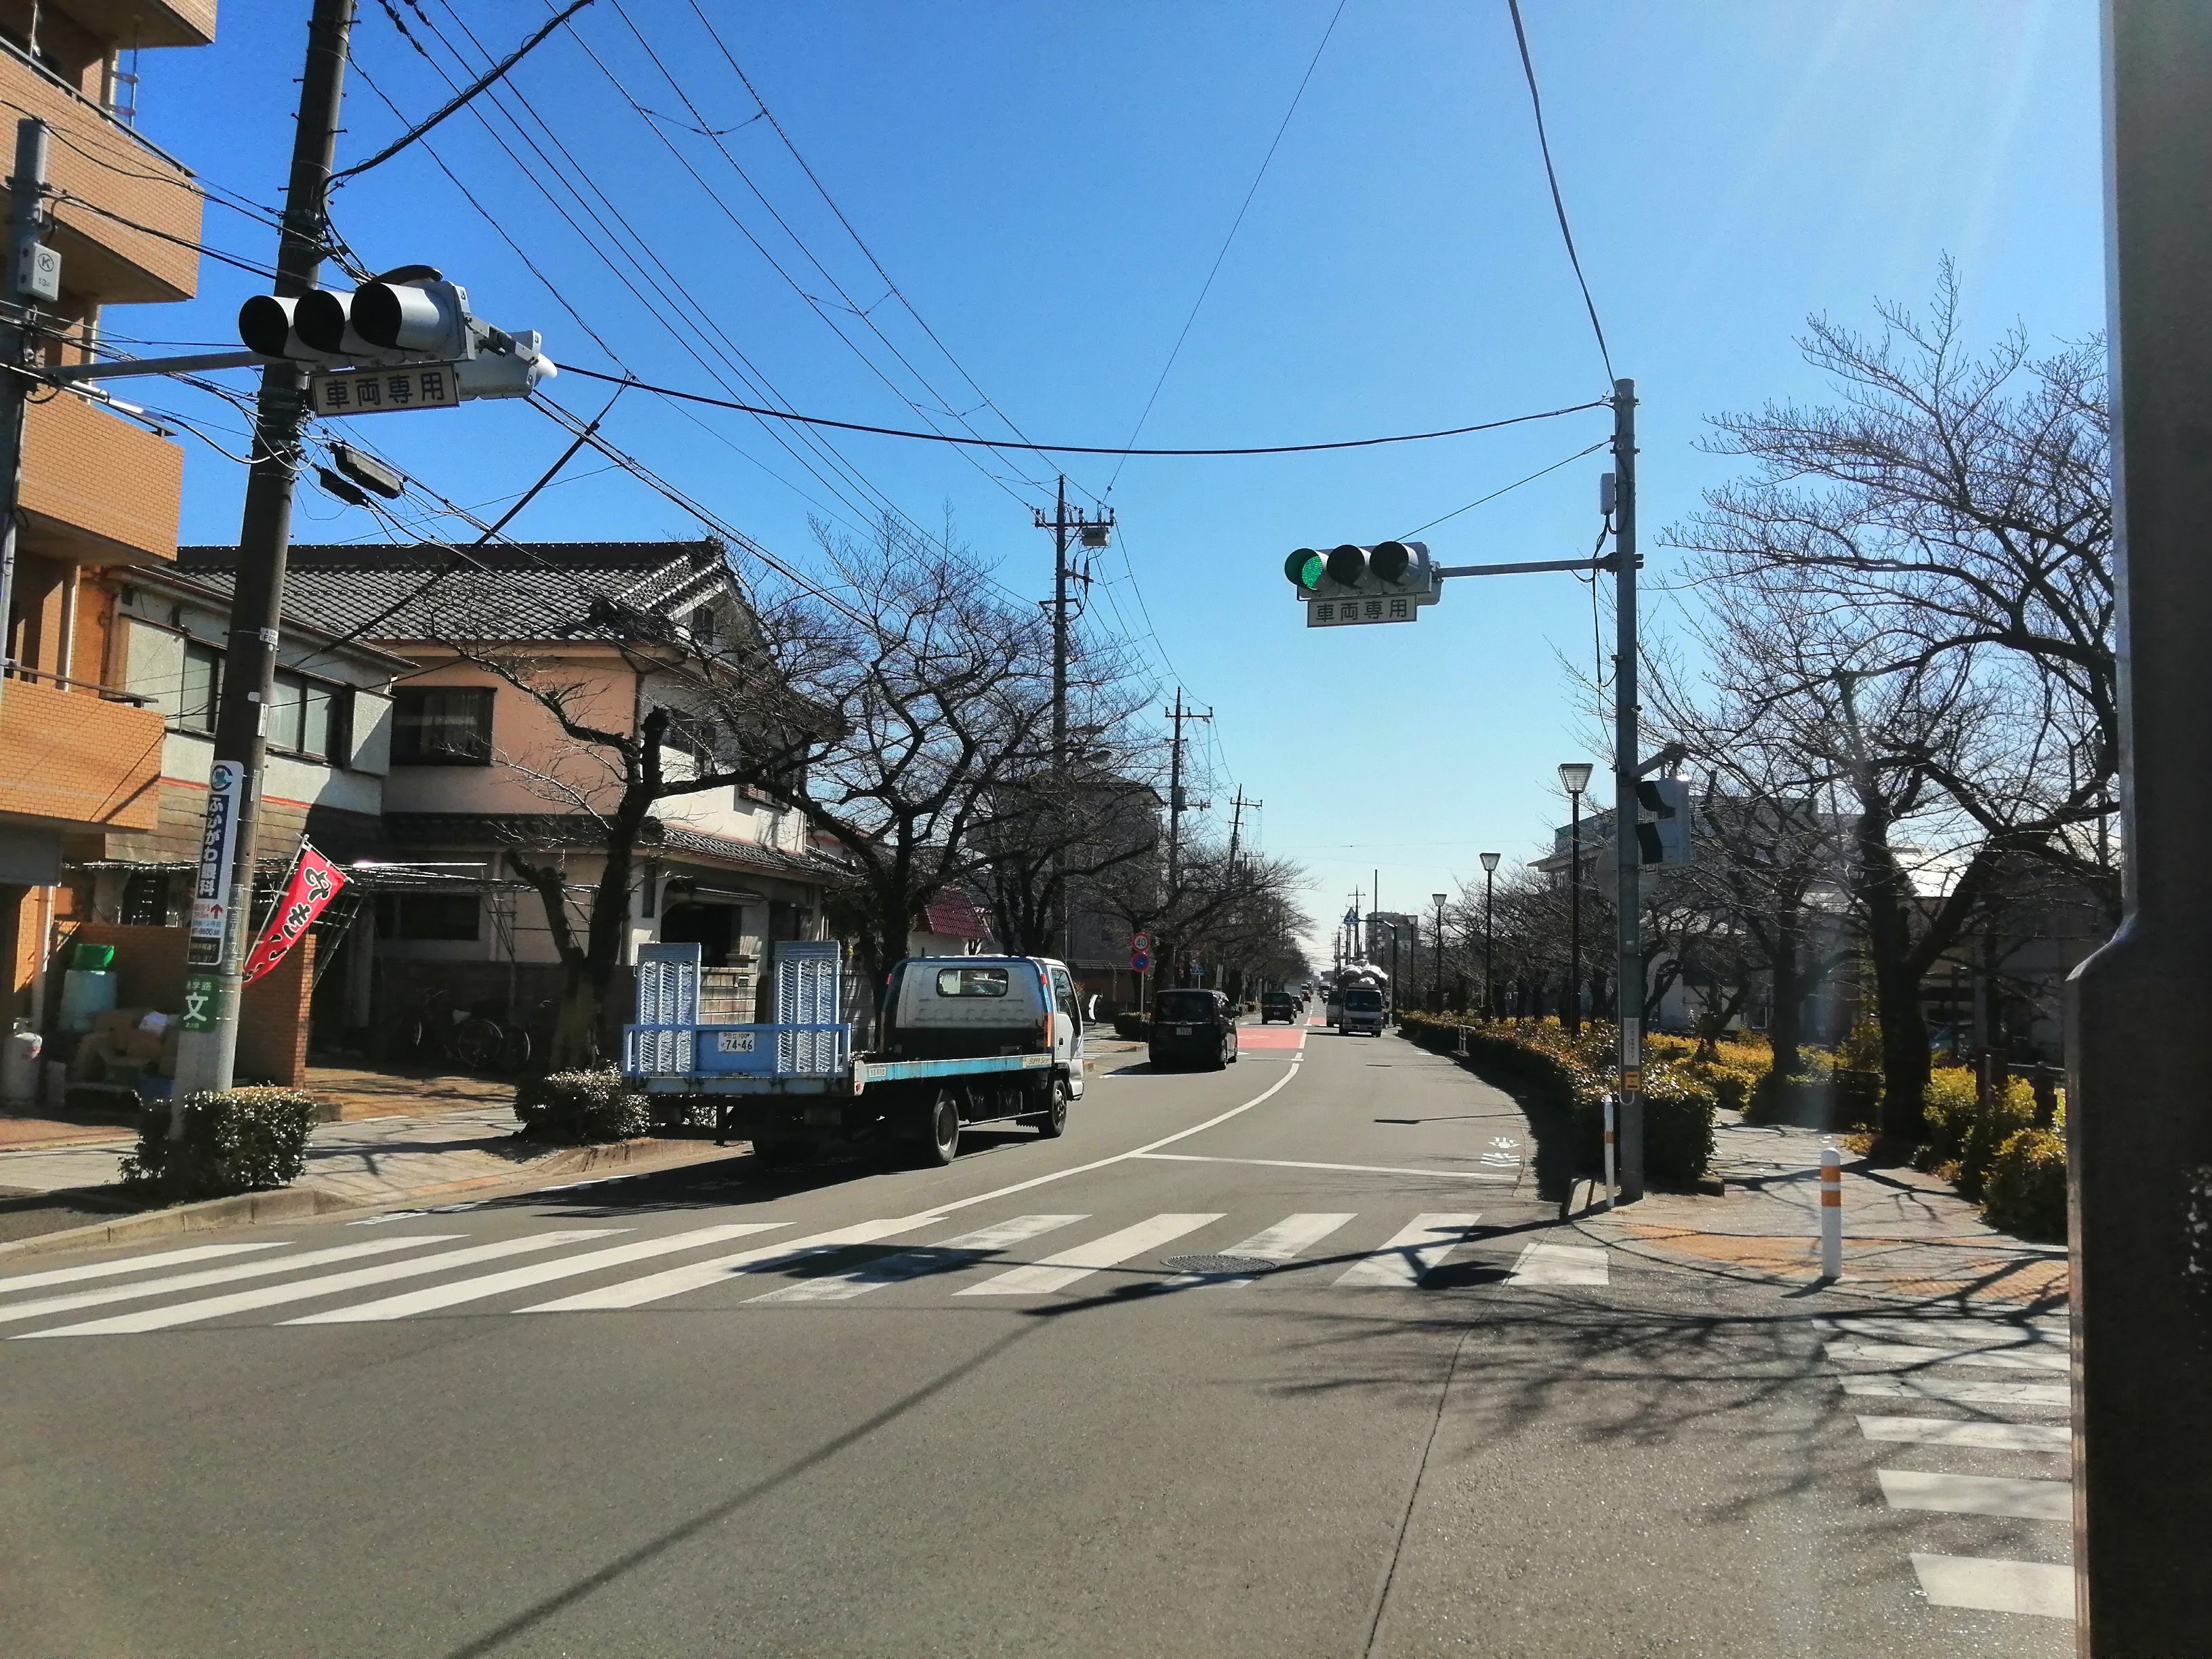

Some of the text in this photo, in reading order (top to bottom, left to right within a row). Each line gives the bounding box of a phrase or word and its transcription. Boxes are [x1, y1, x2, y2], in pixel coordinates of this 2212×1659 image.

[325, 372, 445, 409] 車両専用
[1316, 599, 1407, 622] 車両専用
[1136, 938, 1146, 947] 40
[184, 991, 209, 1021] 文
[726, 1040, 752, 1050] 74-46
